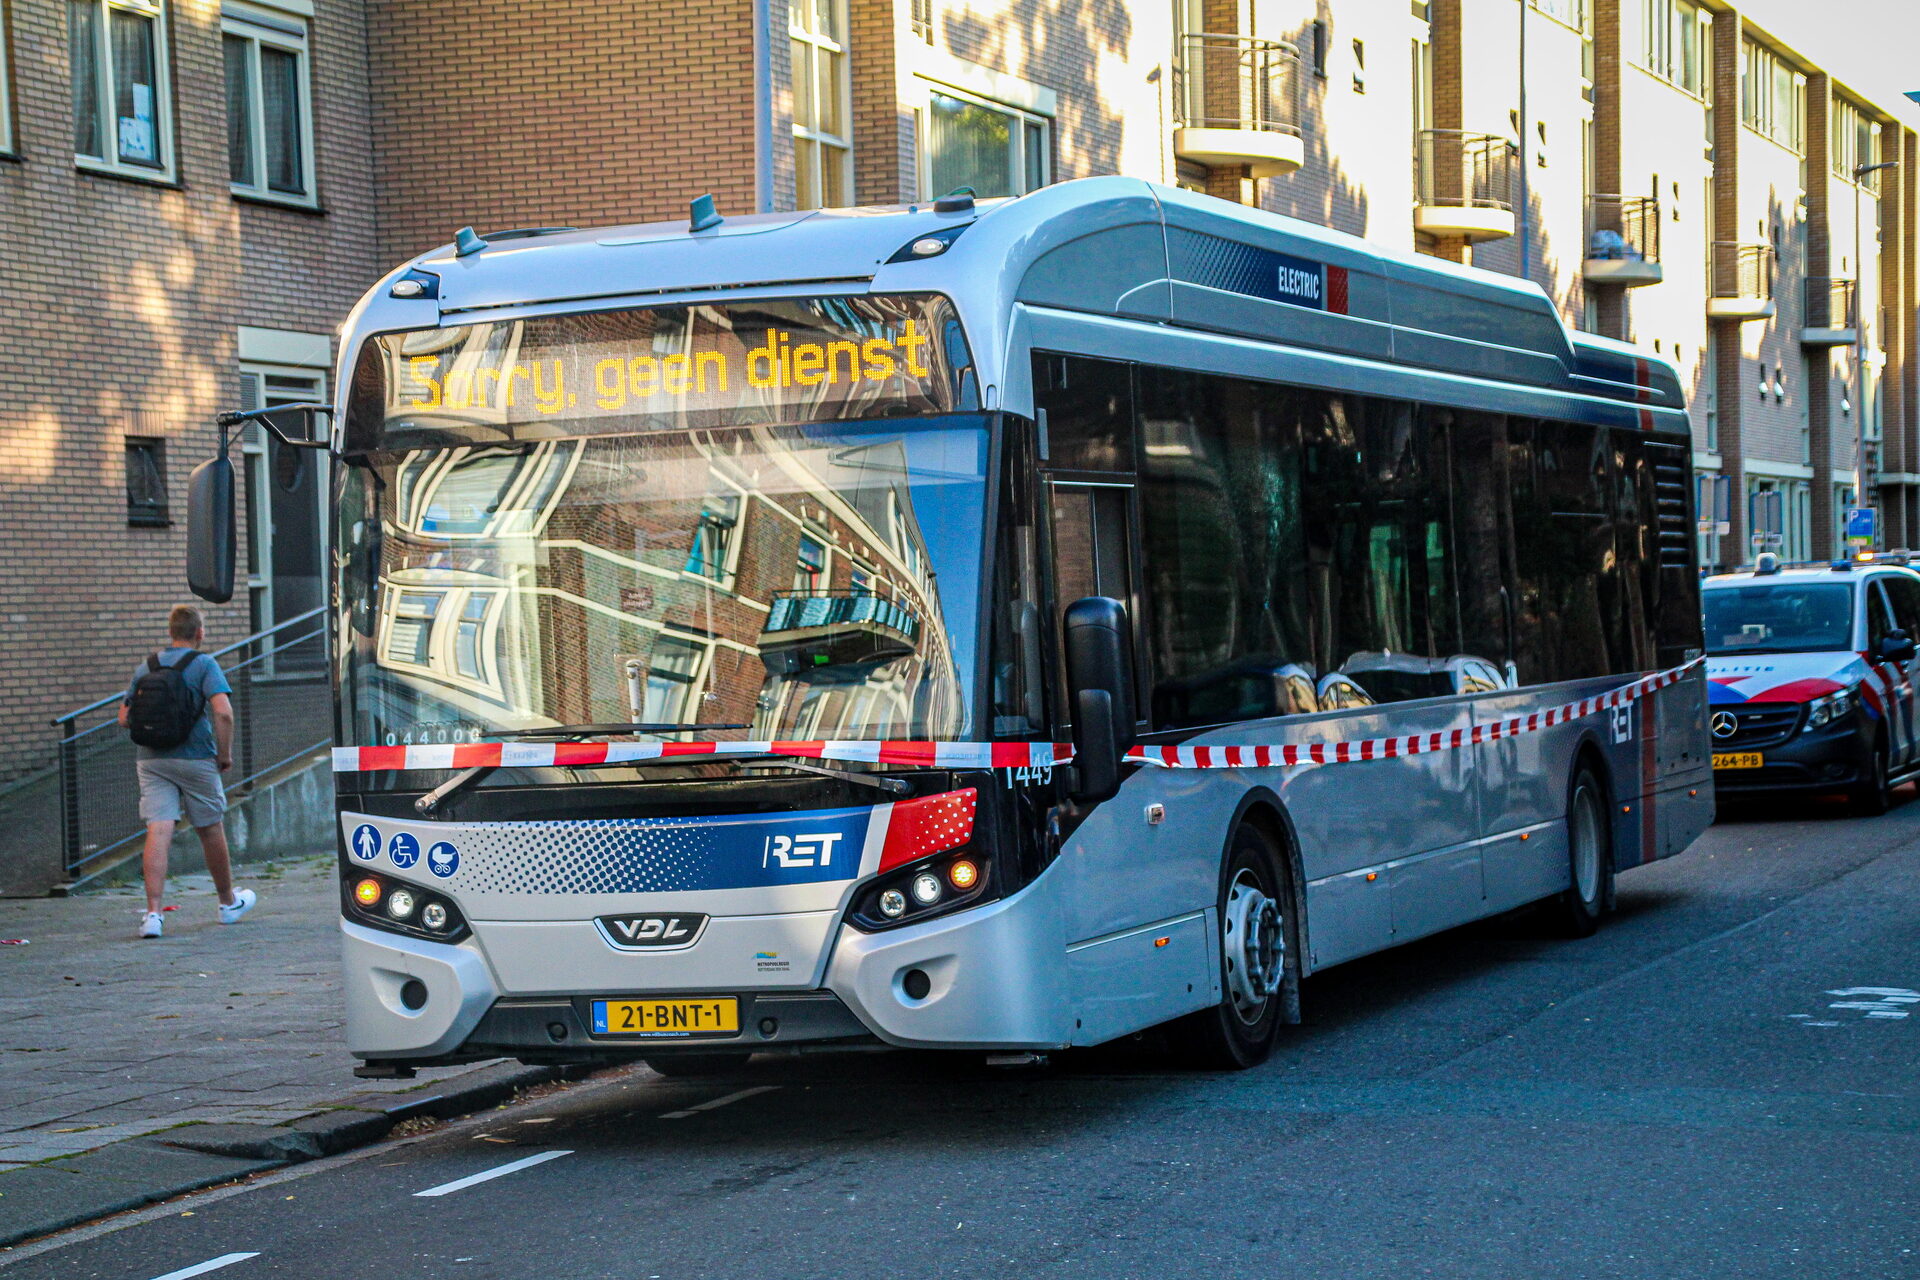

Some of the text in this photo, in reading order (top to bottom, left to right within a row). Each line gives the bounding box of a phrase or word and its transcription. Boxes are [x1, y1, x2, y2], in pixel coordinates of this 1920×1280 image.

[1279, 266, 1319, 299] ELECTRIC
[410, 318, 929, 414] Sorry, geen dienst
[1610, 699, 1634, 745] RET
[1006, 752, 1052, 790] 1449
[1712, 755, 1760, 768] 264-PB
[762, 832, 843, 869] RET
[613, 918, 688, 940] VDL
[596, 1020, 606, 1028] NL
[620, 1004, 721, 1029] 21-BNT-1
